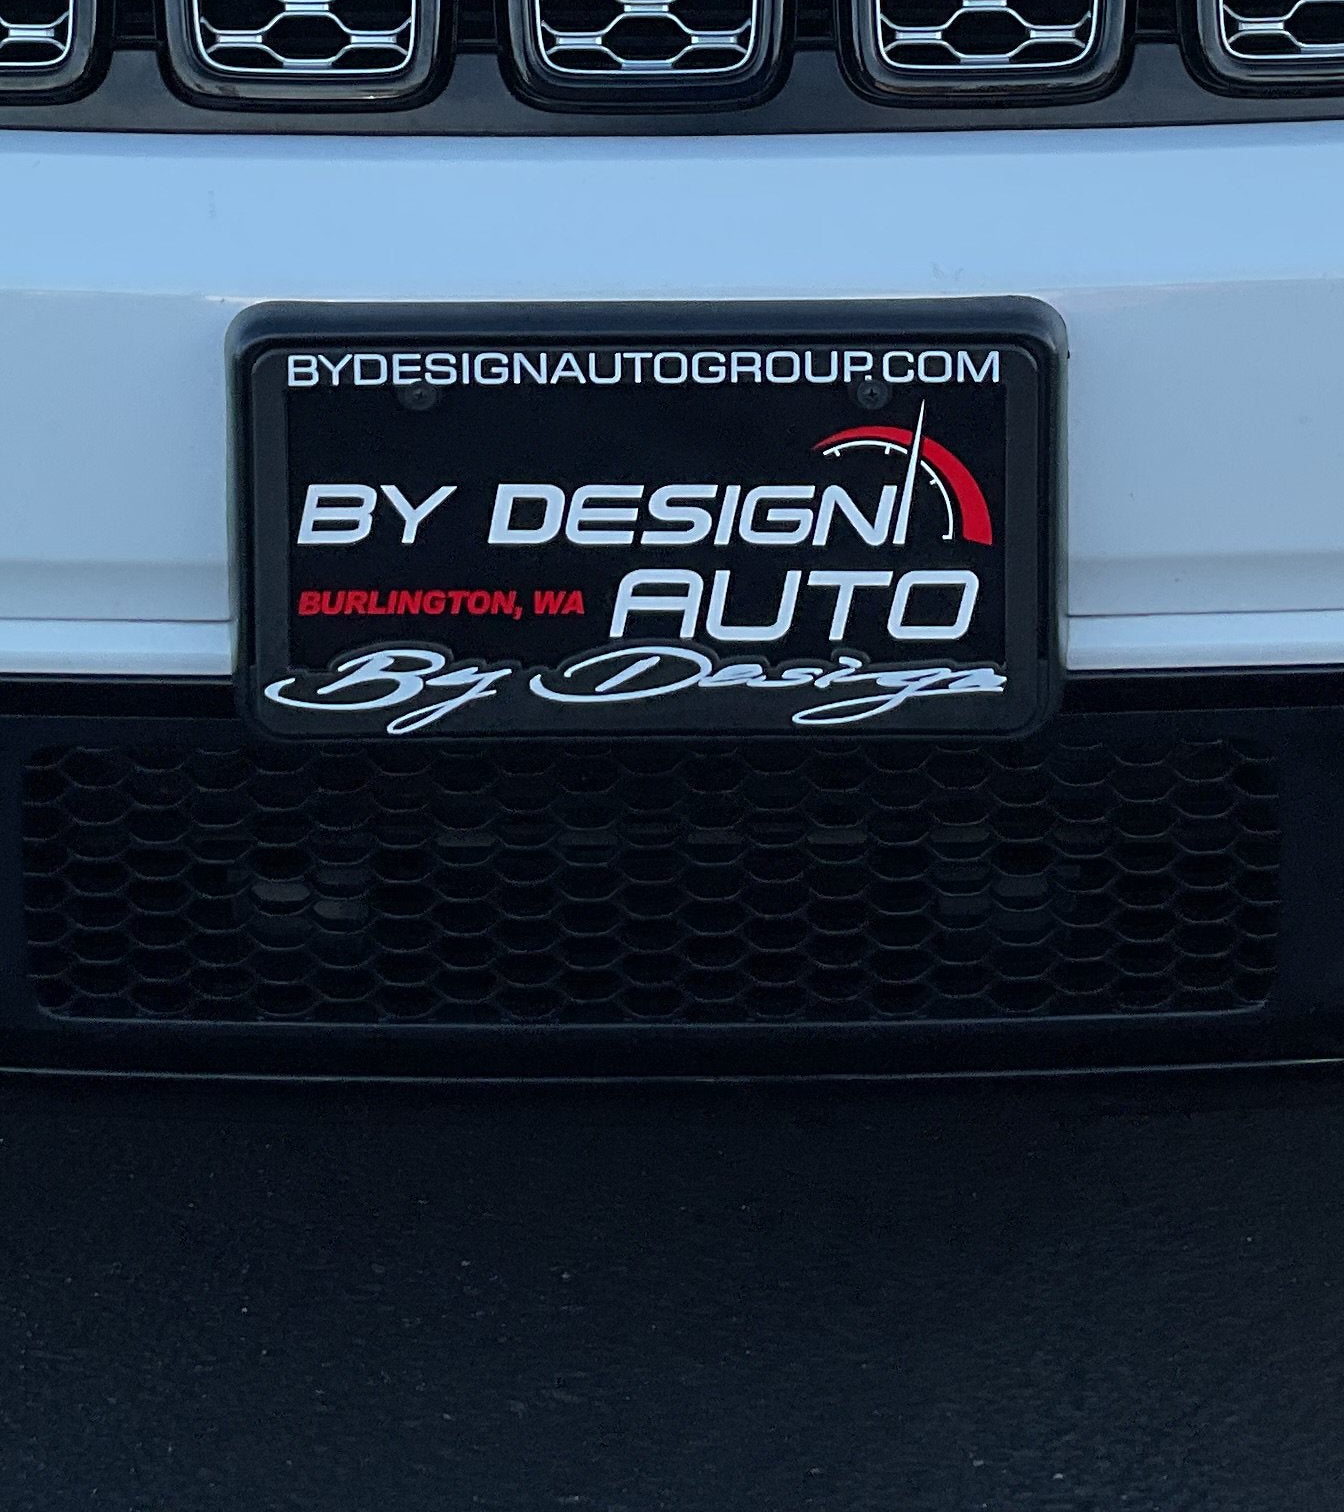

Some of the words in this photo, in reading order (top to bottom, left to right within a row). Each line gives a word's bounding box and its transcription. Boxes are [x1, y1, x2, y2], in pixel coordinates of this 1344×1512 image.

[287, 350, 1001, 387] BYDESIGNAUTOGROUP.COM
[296, 483, 457, 545] BY
[487, 483, 898, 547] DESIGN
[298, 590, 523, 620] BURLINGTON,
[533, 590, 586, 616] WA
[608, 568, 980, 642] AUTO
[264, 649, 513, 735] By
[529, 645, 1008, 726] Design
